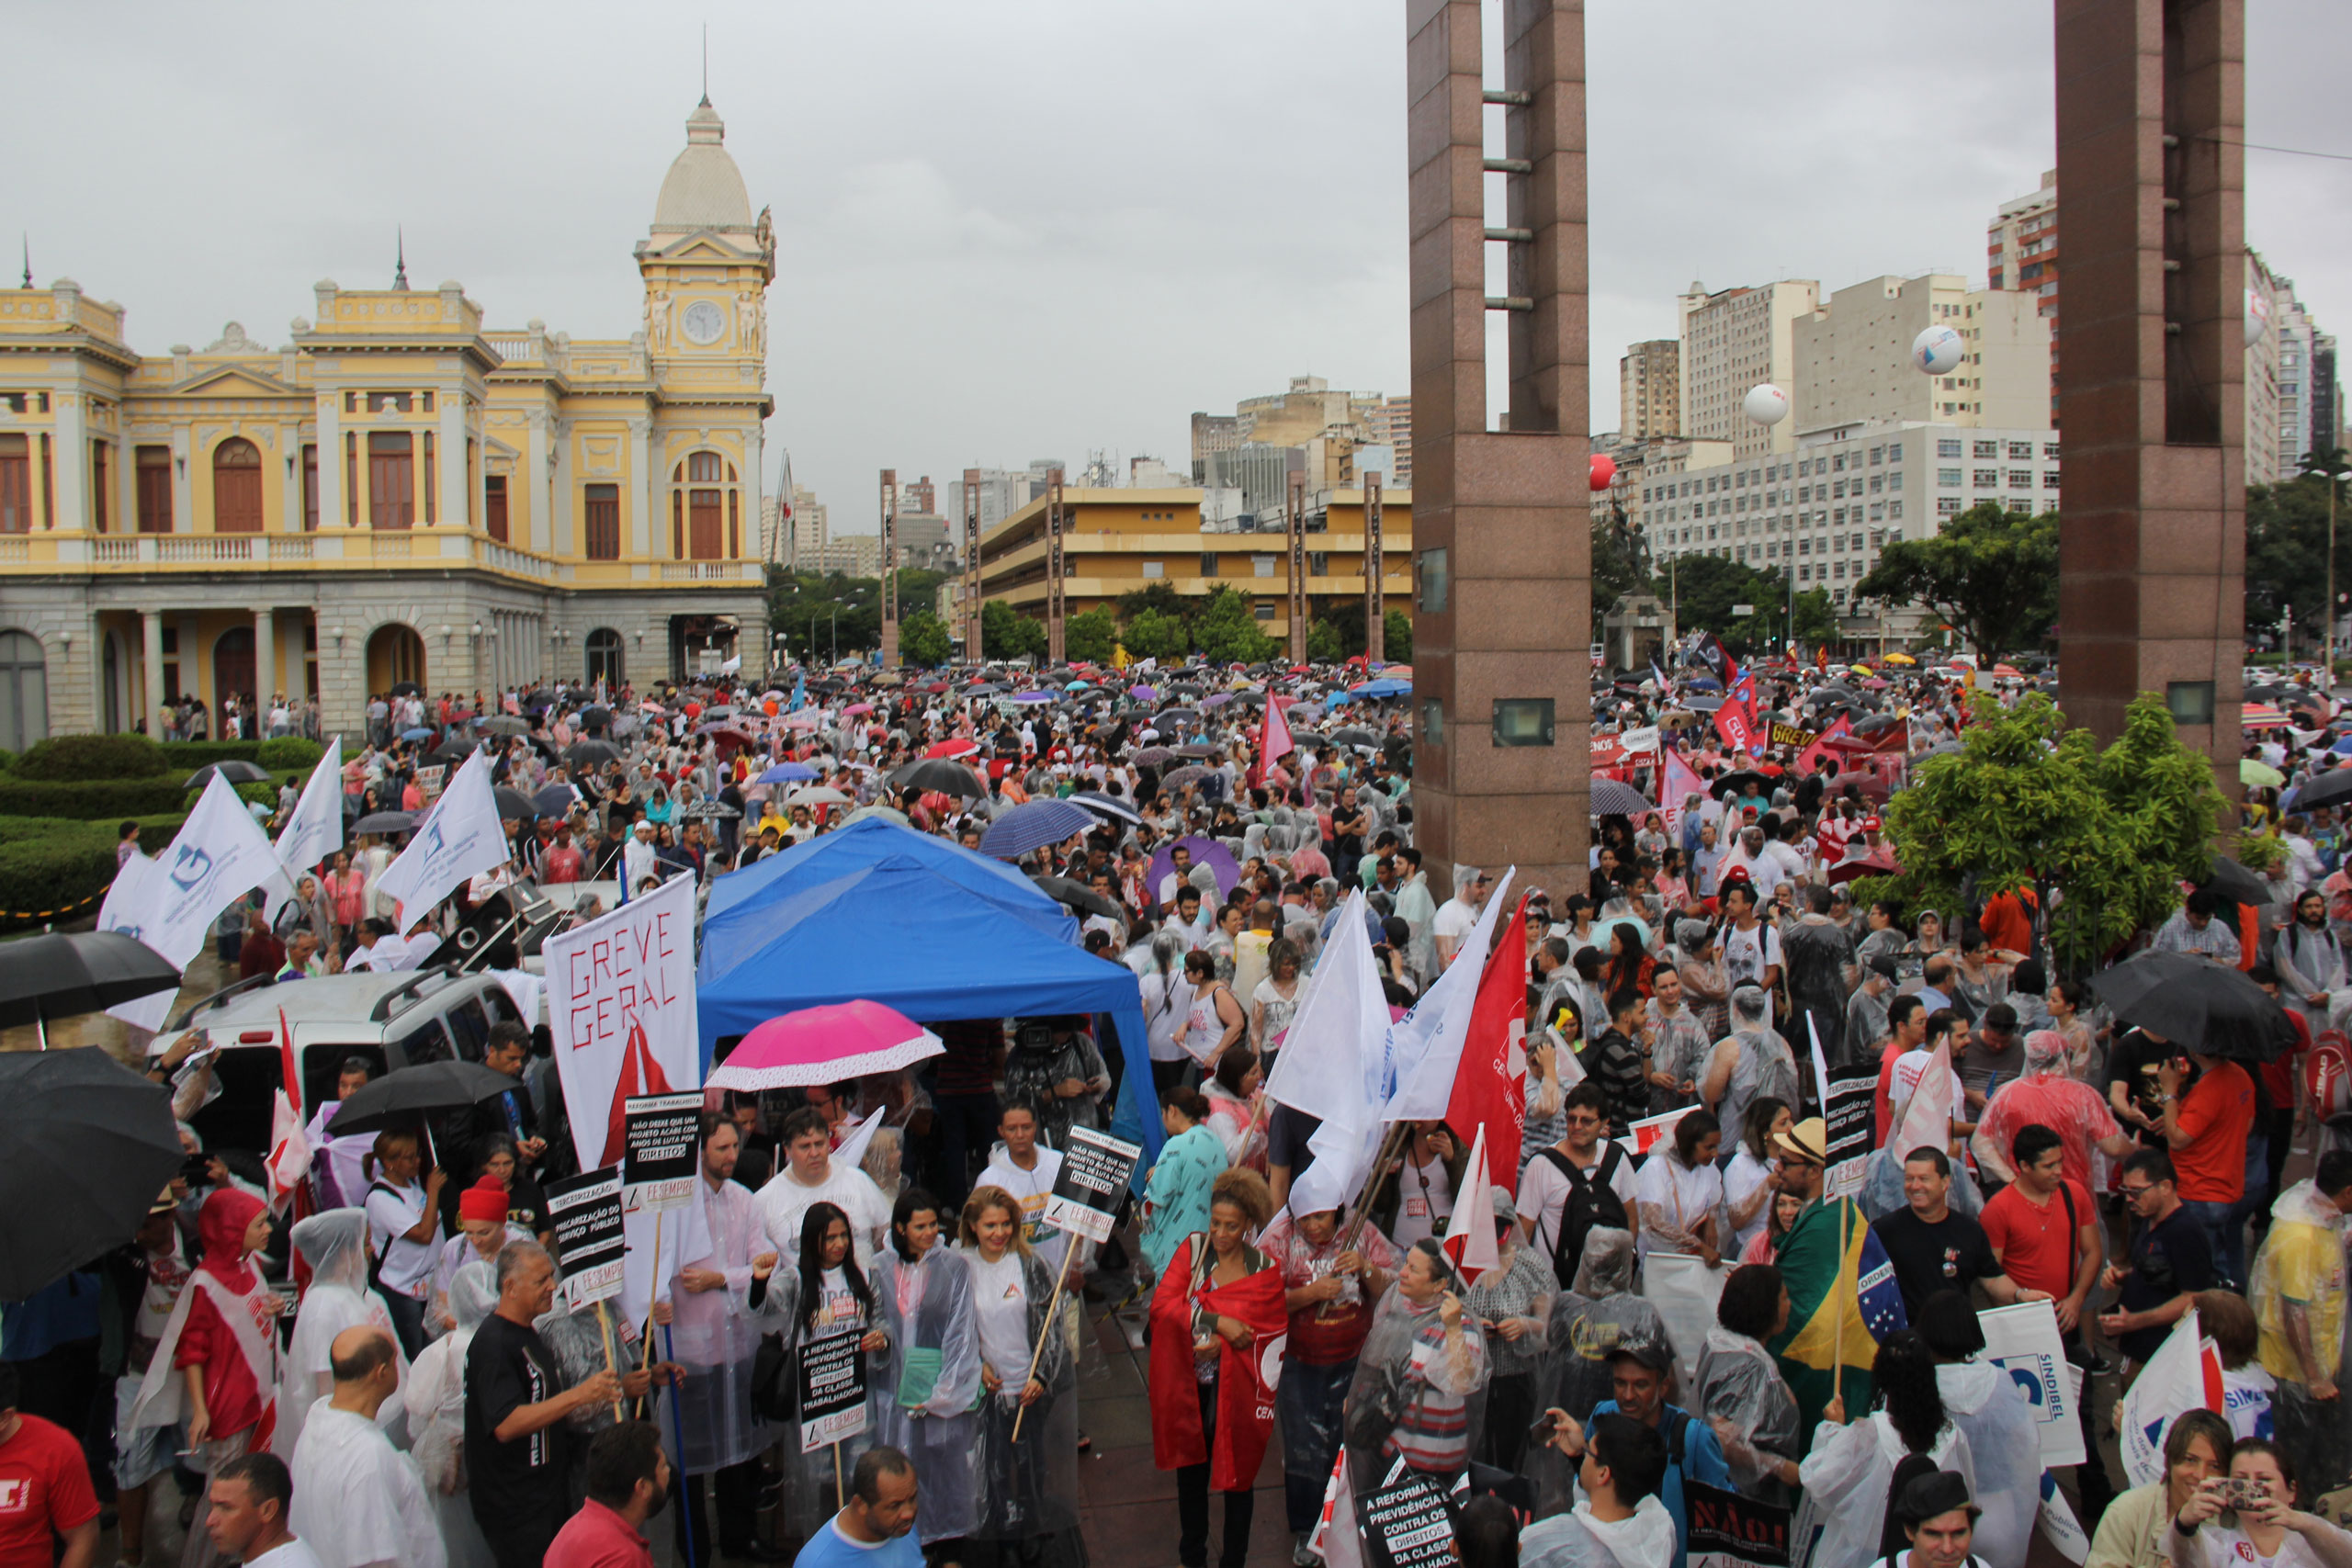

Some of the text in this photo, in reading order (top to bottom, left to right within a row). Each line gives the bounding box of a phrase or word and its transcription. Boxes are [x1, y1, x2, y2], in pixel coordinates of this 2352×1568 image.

[571, 912, 673, 1001] GREVE
[571, 966, 676, 1052] GERAL
[2315, 1055, 2328, 1097] HEAD
[628, 1123, 698, 1140] PROJETO ACABE COM
[632, 1115, 696, 1131] NÃO DEIXE QUE UM
[630, 1134, 695, 1149] ANOS DE LUTA POR
[639, 1147, 684, 1161] DIREITOS
[1067, 1151, 1129, 1179] PROJETO ACABE COM
[1071, 1144, 1129, 1169] NÃO DEIXE QUE UM
[1067, 1160, 1124, 1186] ANOS DE LUTA POR
[1071, 1173, 1113, 1194] DIREITOS
[555, 1207, 607, 1234] PRECARIZAÇÃO
[608, 1204, 620, 1215] DO
[558, 1214, 620, 1244] SERVIÇO PÚBLICO
[803, 1333, 861, 1359] A REFORMA DA
[803, 1341, 861, 1369] PREVIDÊNCIA É
[809, 1355, 854, 1377] CONTRA OS
[815, 1369, 851, 1384] DIREITOS
[803, 1384, 864, 1412] TRABALHADORA
[811, 1377, 854, 1398] DA CLASSE
[2040, 1353, 2064, 1420] SINDIBEL
[1366, 1499, 1375, 1511] A
[1376, 1484, 1429, 1507] REFORMA
[1370, 1490, 1450, 1526] PREVIDÊNCIA É
[1384, 1509, 1448, 1537] CONTRA OS
[1395, 1526, 1445, 1549] DIREITOS
[1394, 1551, 1411, 1566] DA
